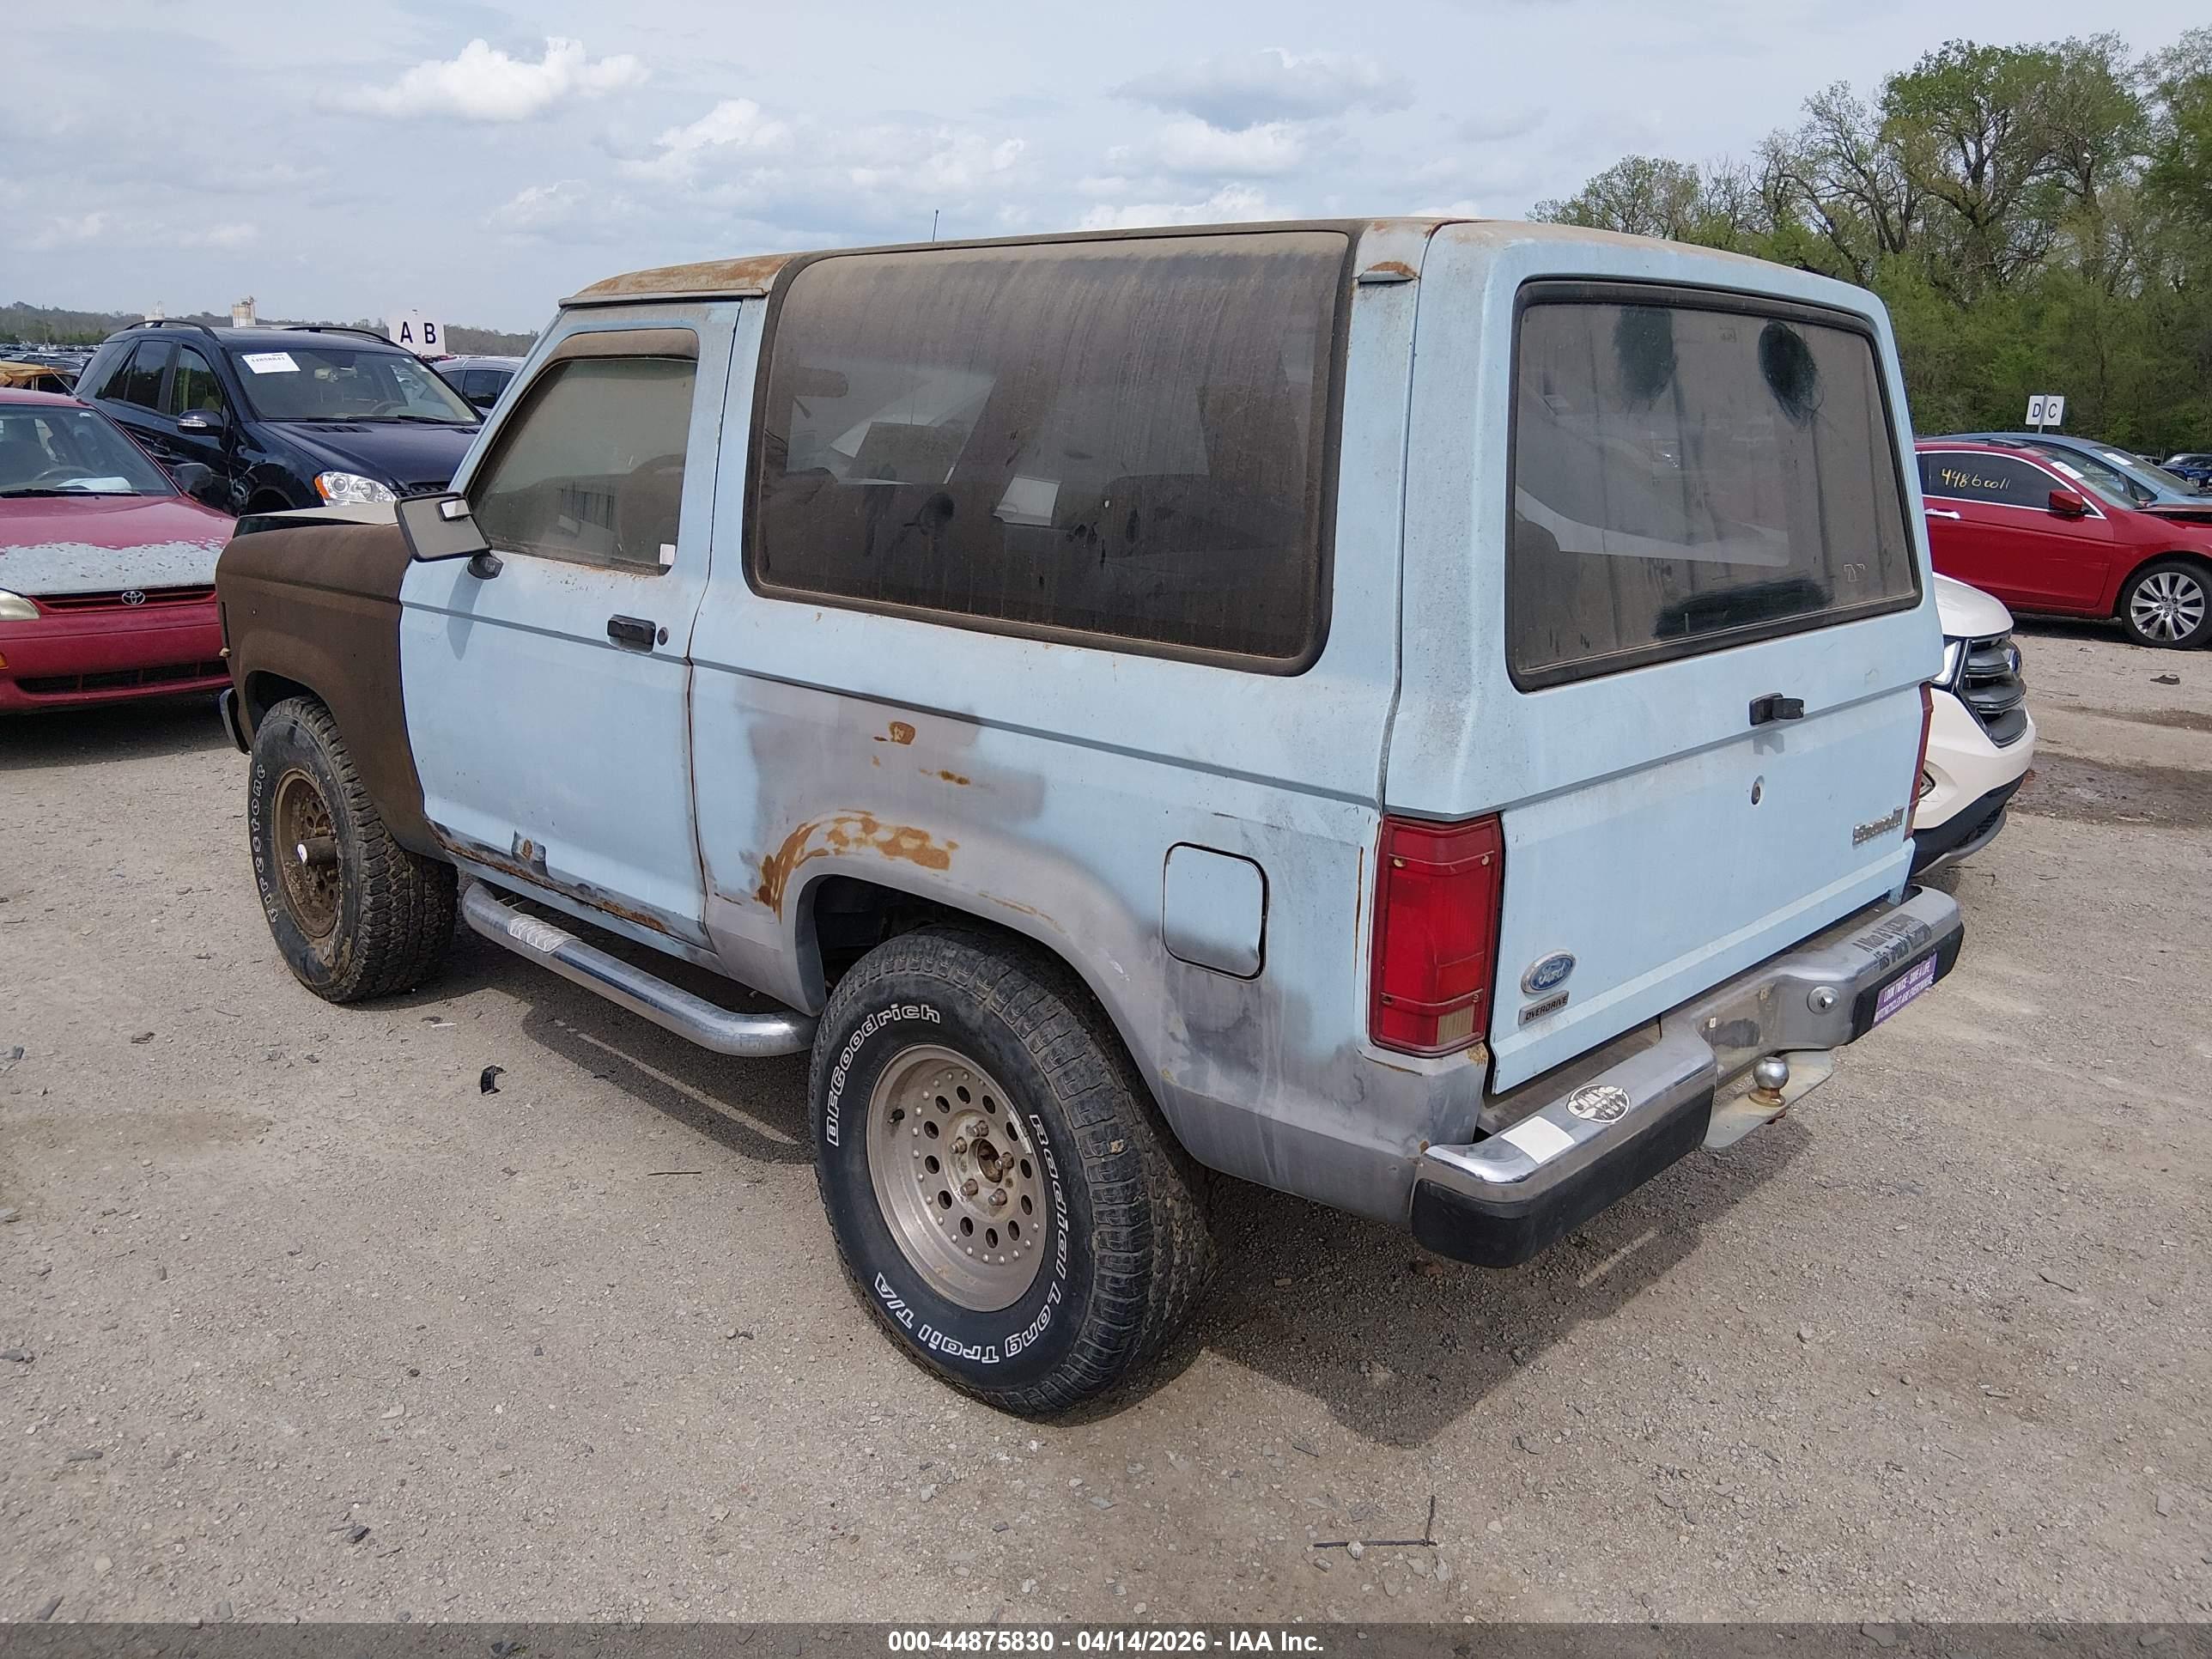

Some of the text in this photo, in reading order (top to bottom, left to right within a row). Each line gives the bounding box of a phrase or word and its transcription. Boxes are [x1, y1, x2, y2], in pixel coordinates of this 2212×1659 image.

[400, 321, 436, 344] A B
[2033, 403, 2057, 418] D C
[1538, 960, 1566, 986] Ford
[1525, 994, 1567, 1021] OVERDRIVE
[826, 1003, 941, 1147] BFGoodrich
[873, 1114, 1069, 1364] Radial Long Trail T/A
